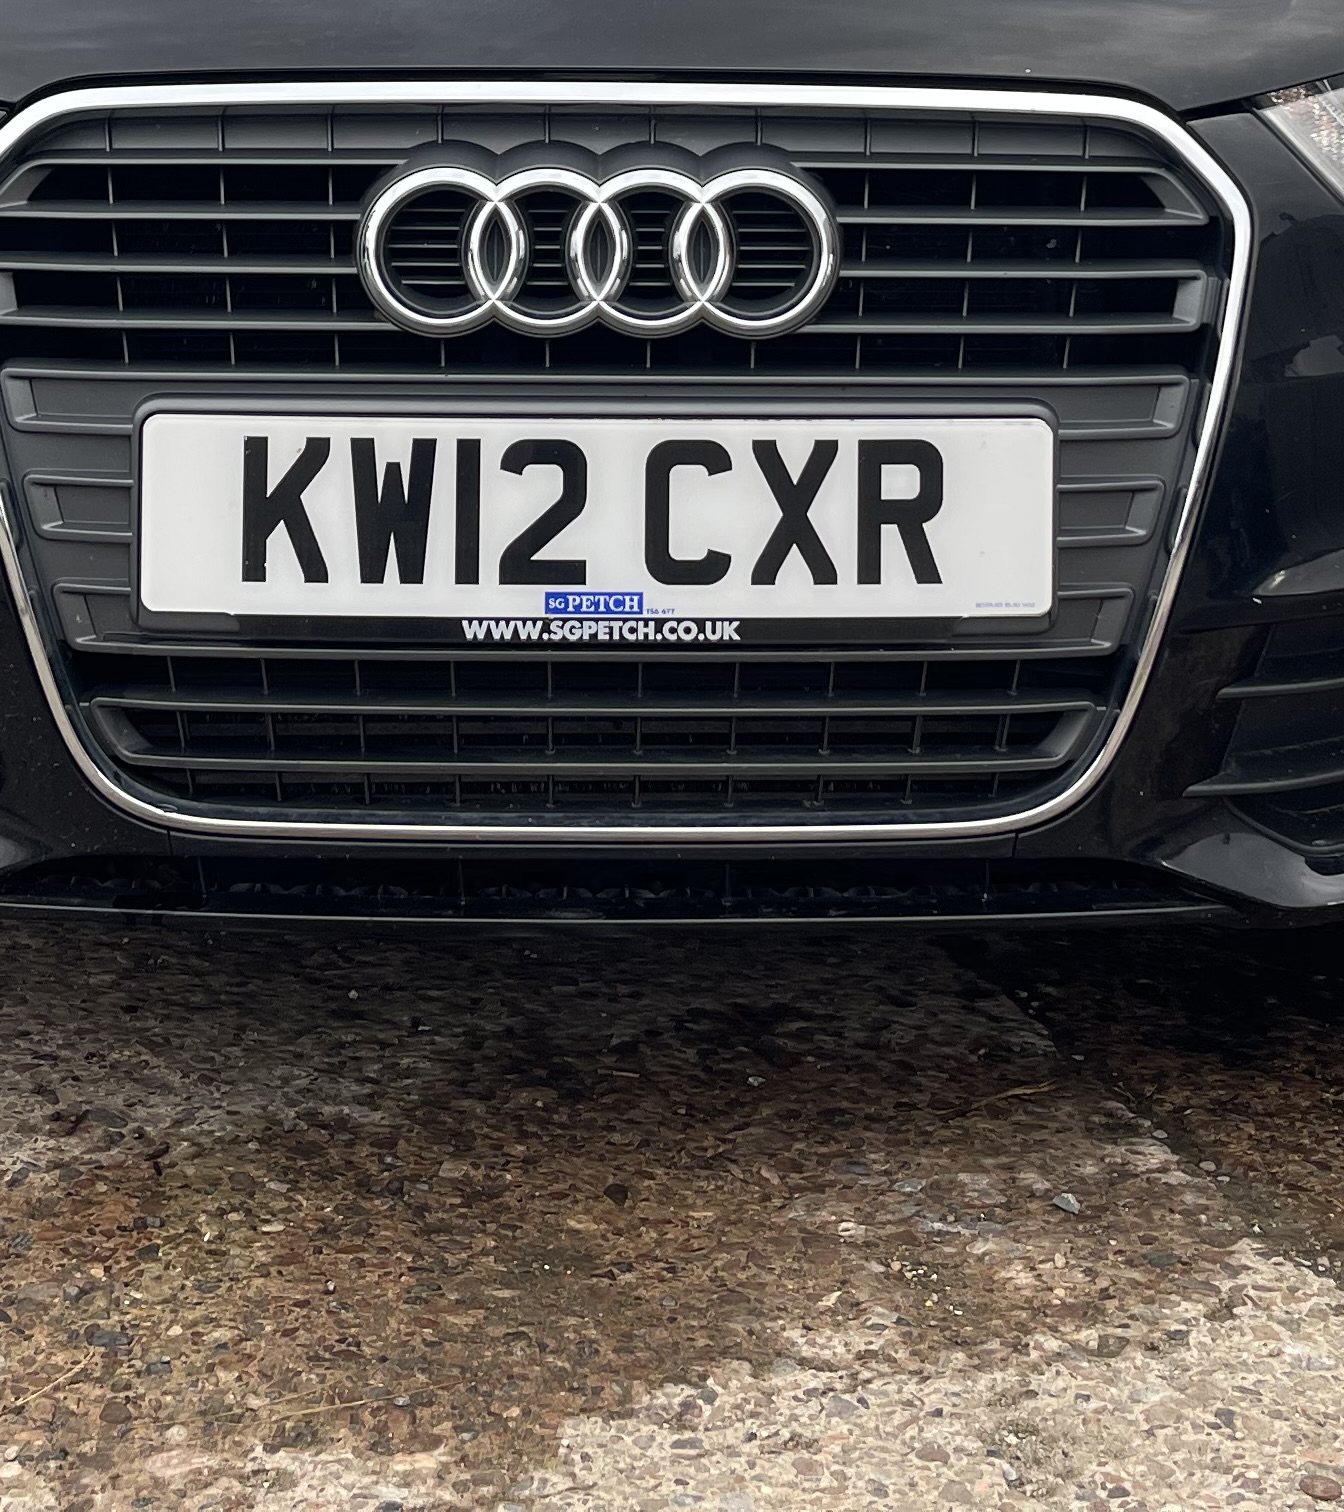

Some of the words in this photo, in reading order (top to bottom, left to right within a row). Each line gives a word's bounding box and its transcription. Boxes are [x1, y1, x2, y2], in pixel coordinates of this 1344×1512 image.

[242, 436, 587, 586] KW12
[644, 438, 944, 586] CXR
[548, 597, 565, 609] SG
[566, 594, 640, 612] PETCH
[462, 620, 741, 641] WWW.SGPETCH.CO.UK
